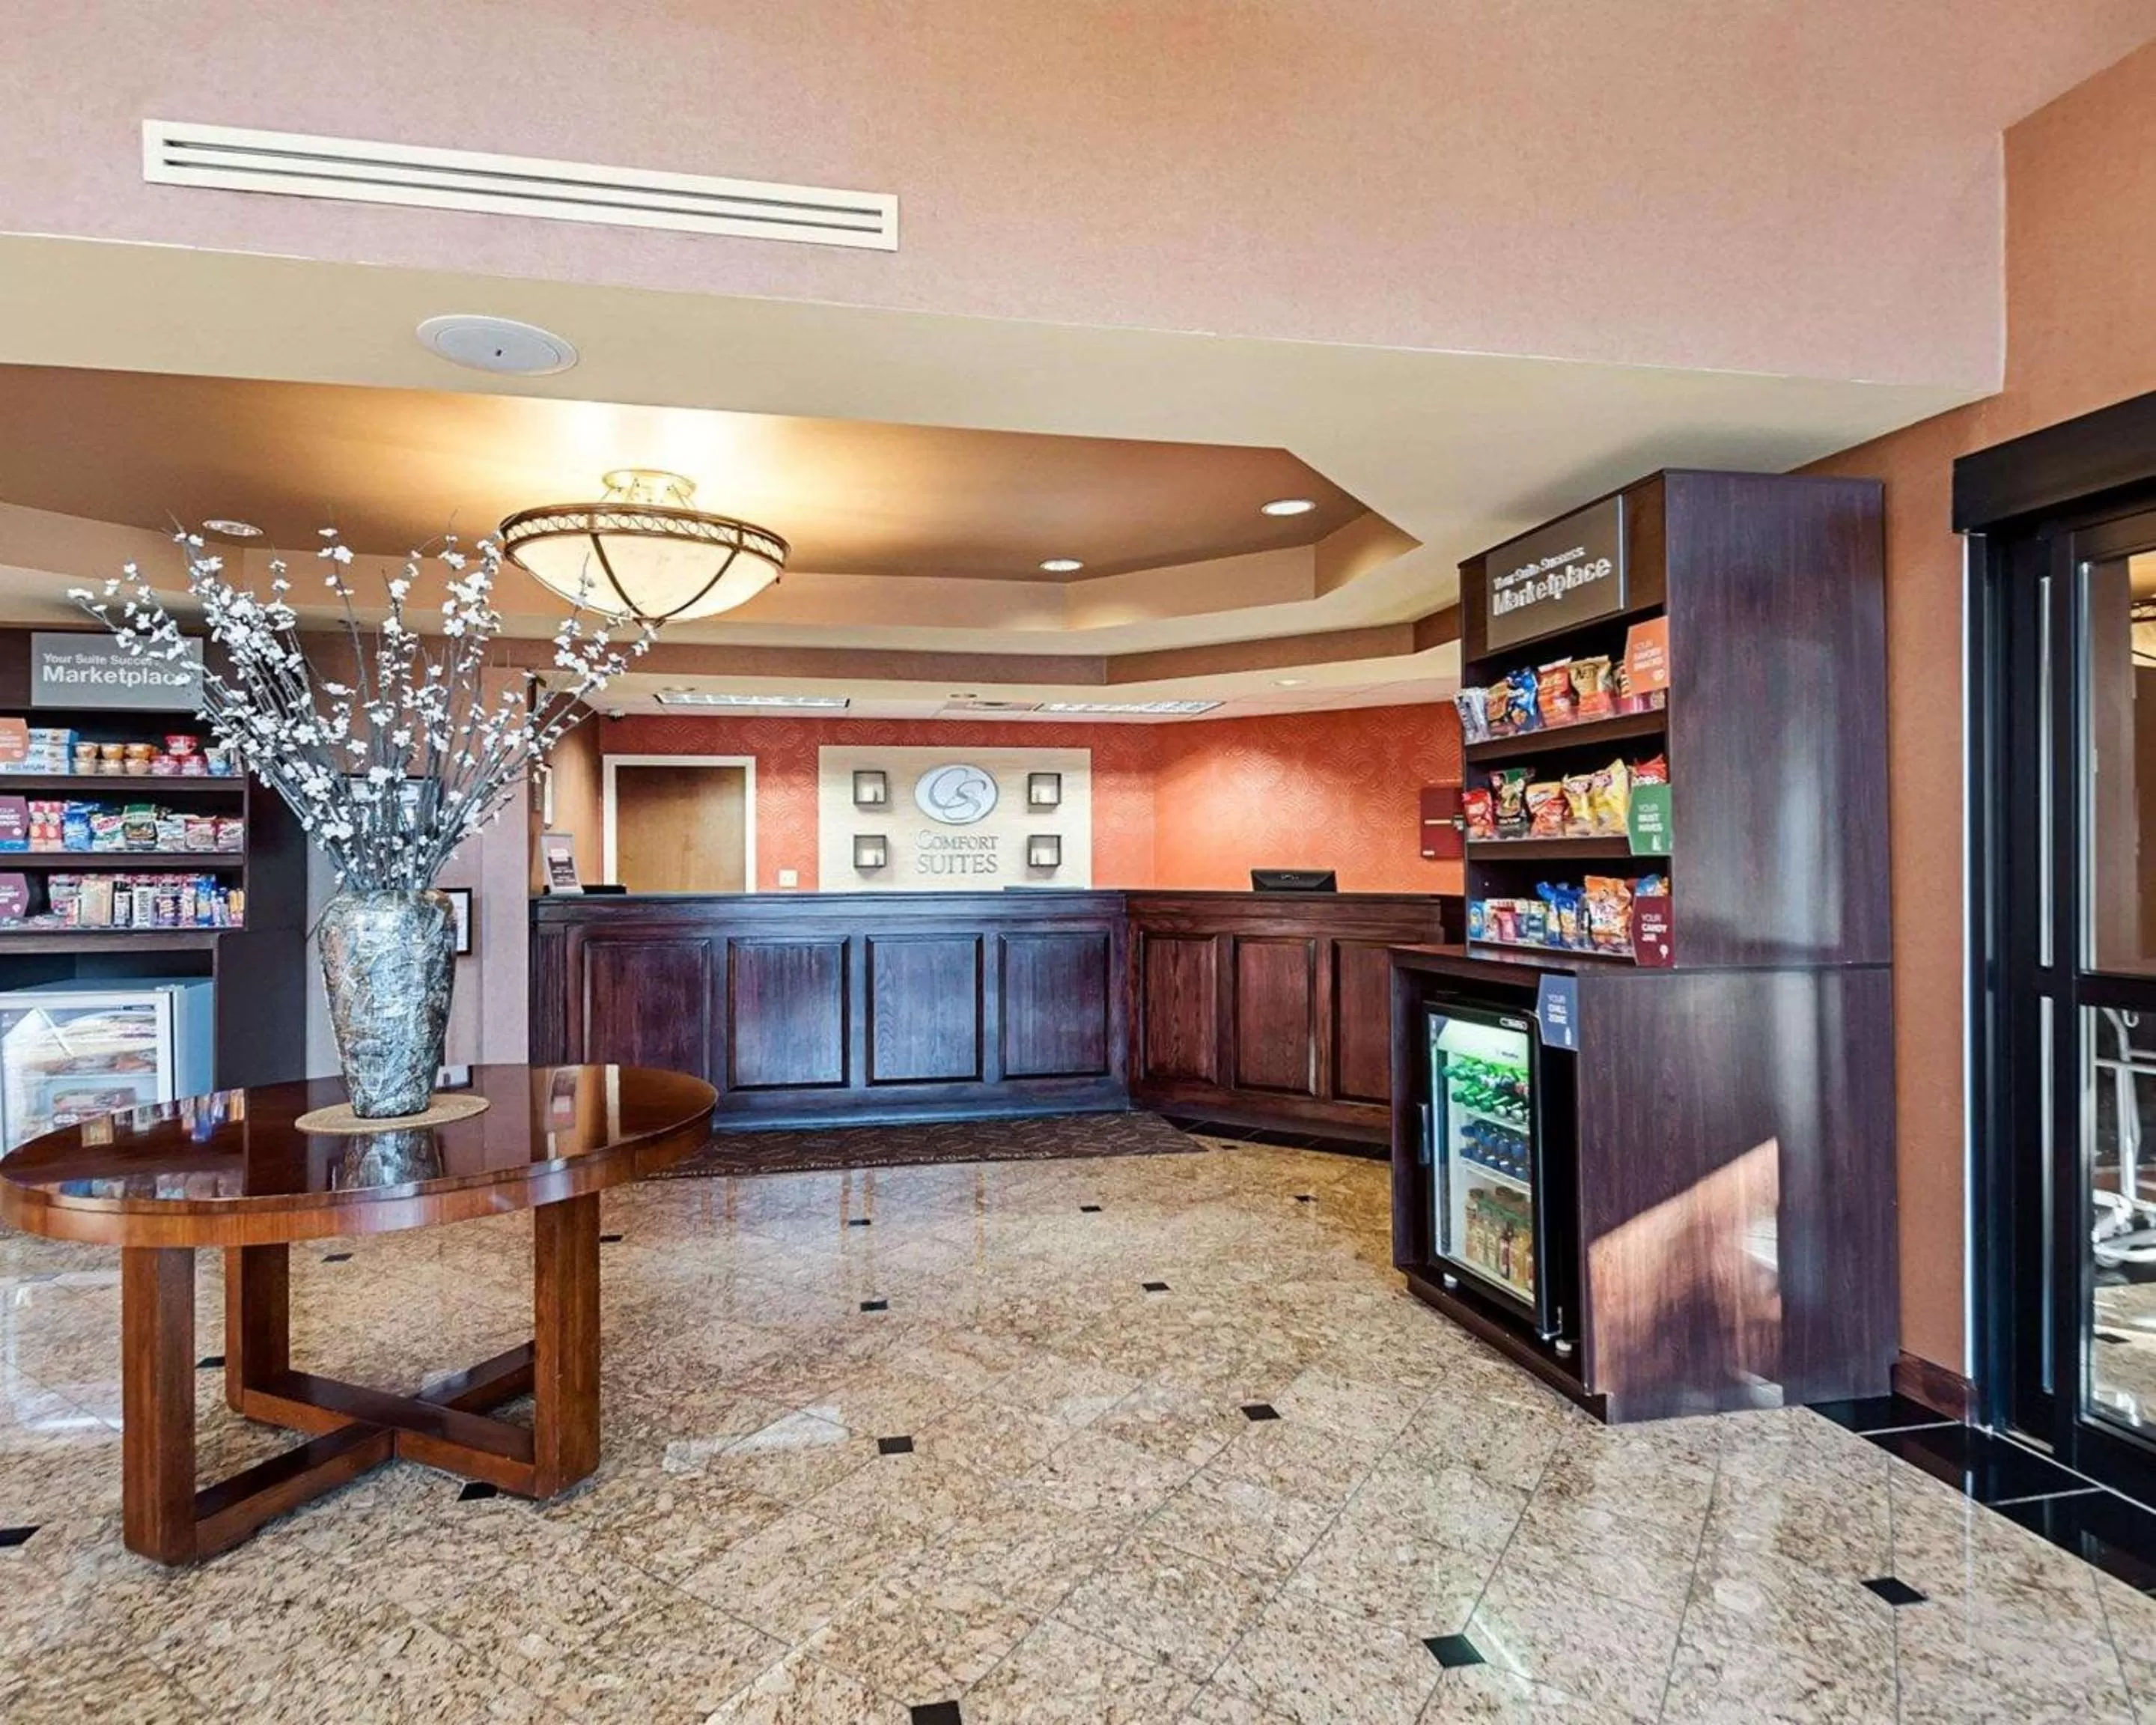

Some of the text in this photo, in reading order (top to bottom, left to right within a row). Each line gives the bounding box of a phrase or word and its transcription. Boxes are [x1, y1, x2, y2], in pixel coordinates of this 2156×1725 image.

[1493, 558, 1612, 615] Marketplace
[42, 653, 73, 664] Your
[74, 654, 107, 665] Suite
[916, 829, 999, 850] COMFORT
[916, 854, 998, 874] SUITES
